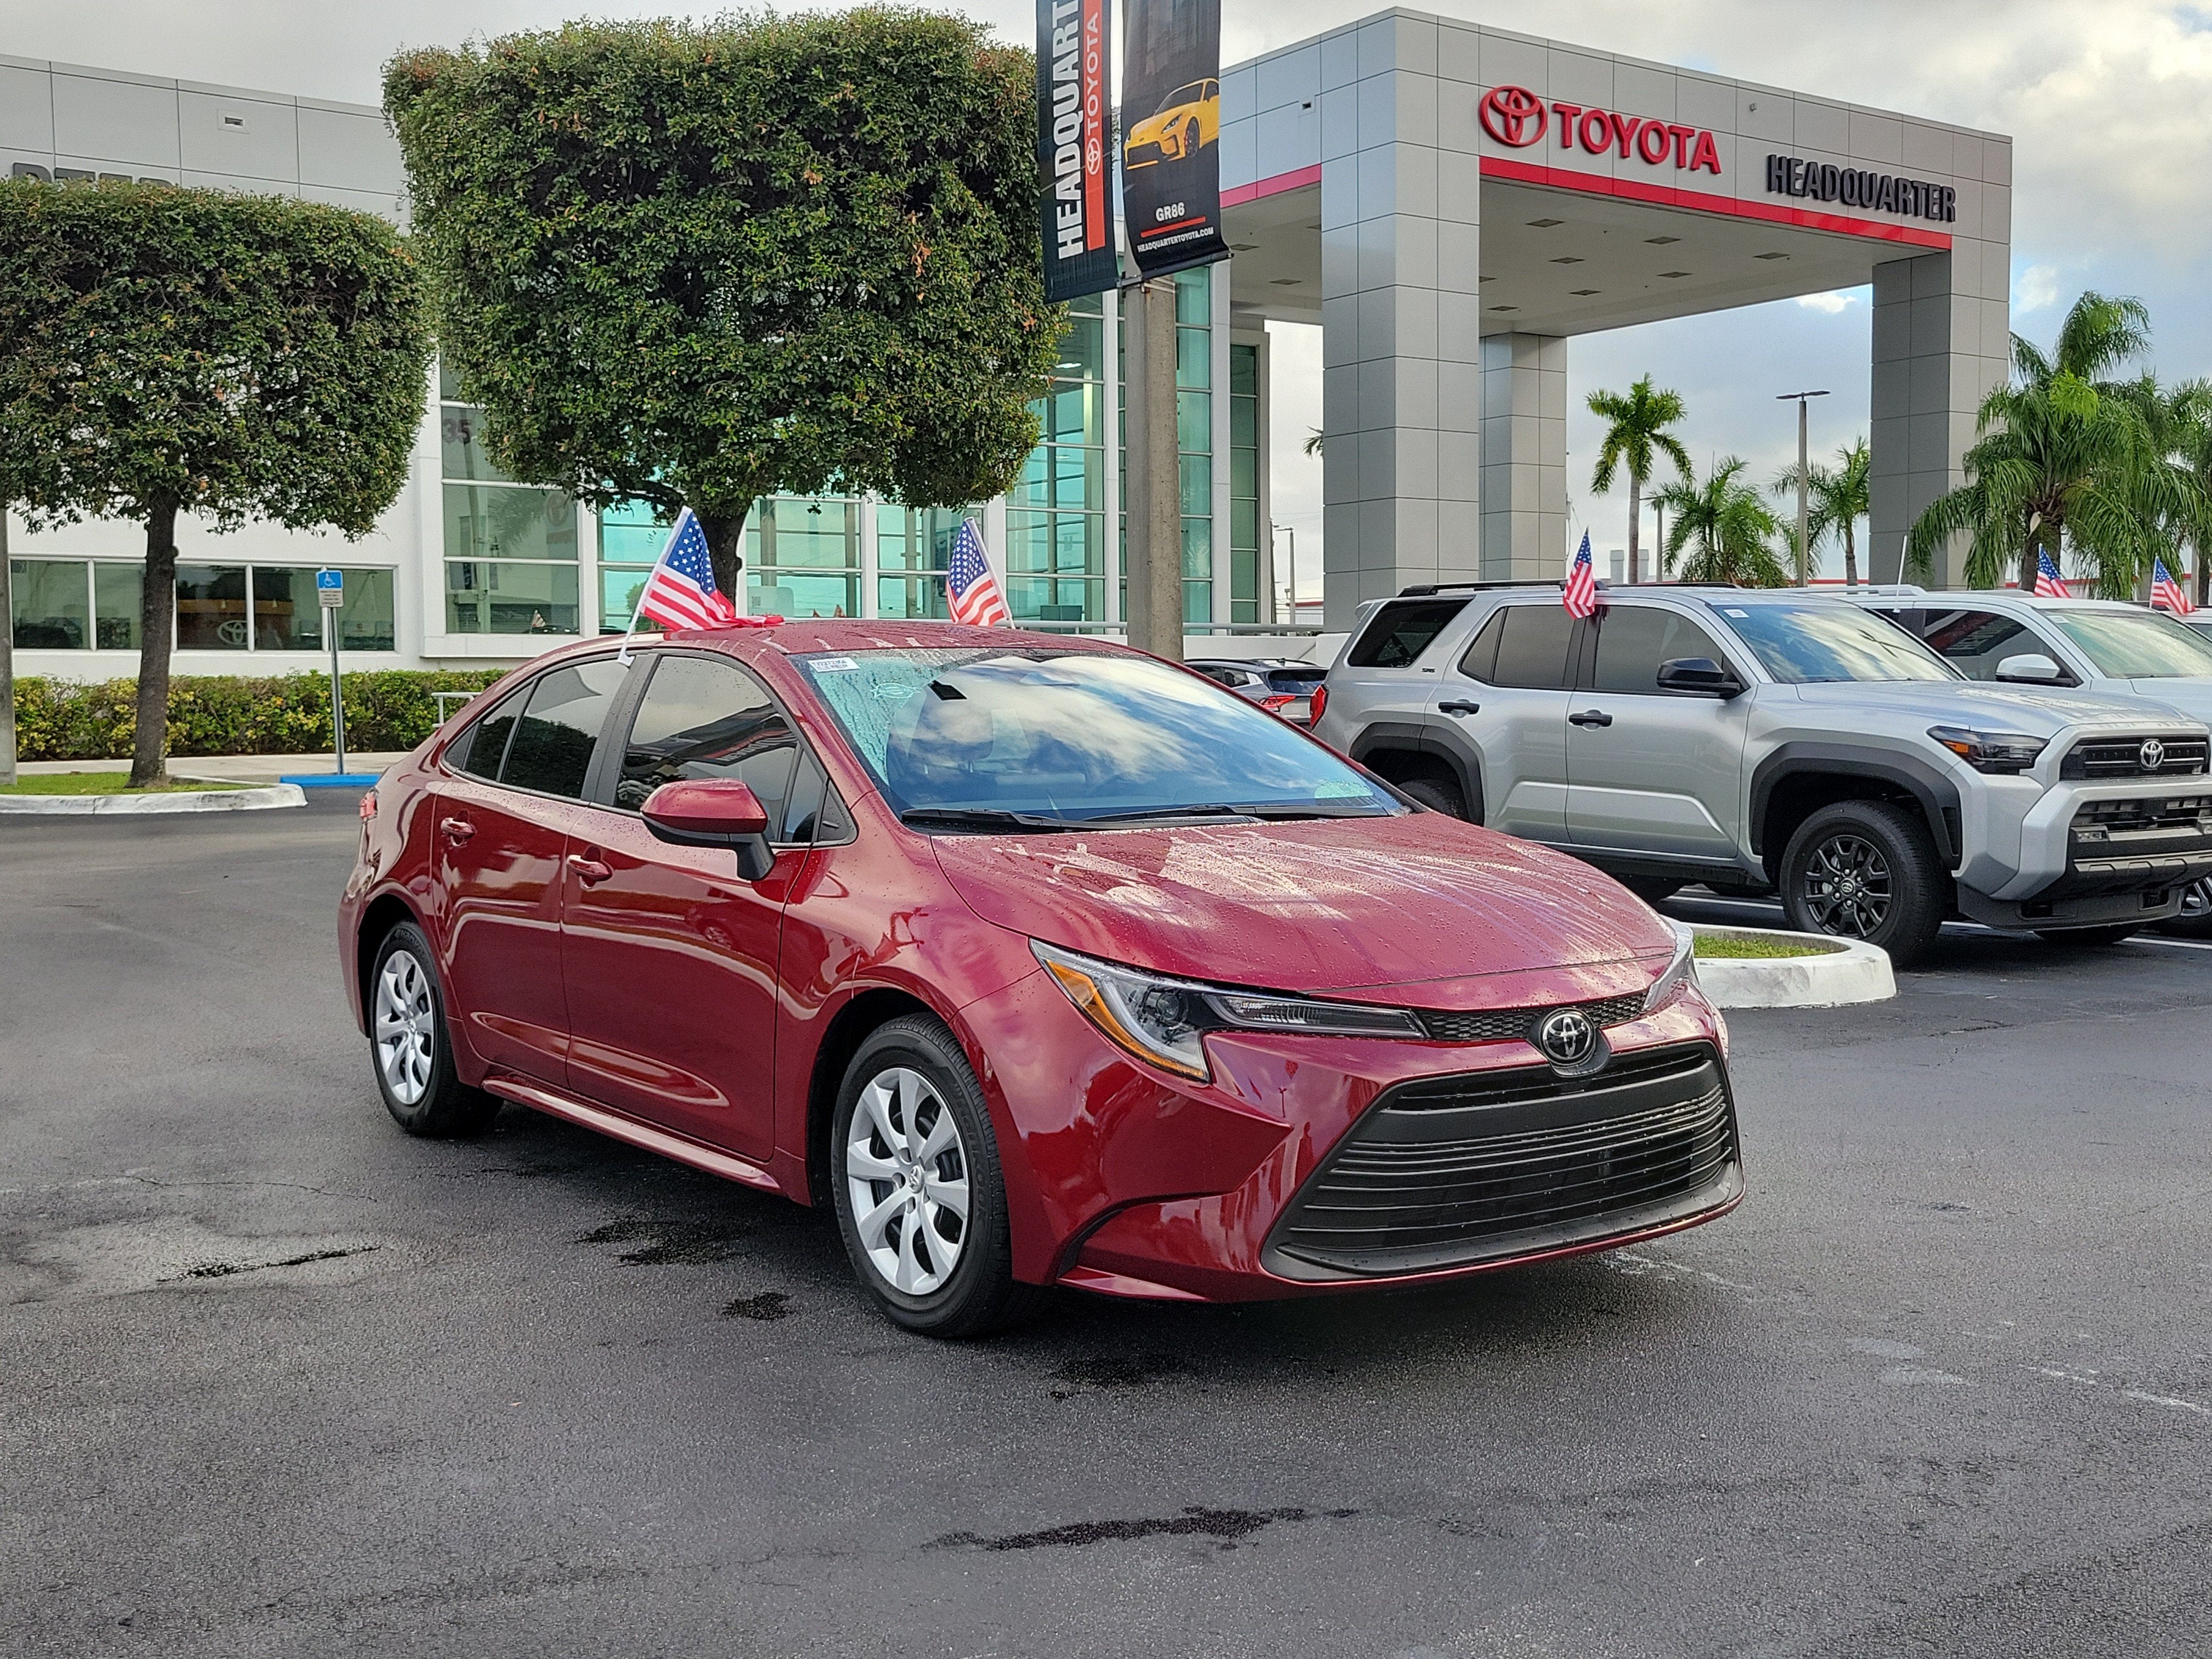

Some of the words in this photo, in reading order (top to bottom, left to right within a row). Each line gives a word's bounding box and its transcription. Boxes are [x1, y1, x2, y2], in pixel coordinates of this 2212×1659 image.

[1086, 12, 1098, 136] TOYOTA
[1052, 0, 1084, 259] HEADQUART
[1552, 103, 1722, 174] TOYOTA
[1155, 202, 1185, 222] GR86
[1767, 154, 1956, 223] HEADQUARTER
[1137, 227, 1214, 253] HEADQUARTERTOYOTA.COM
